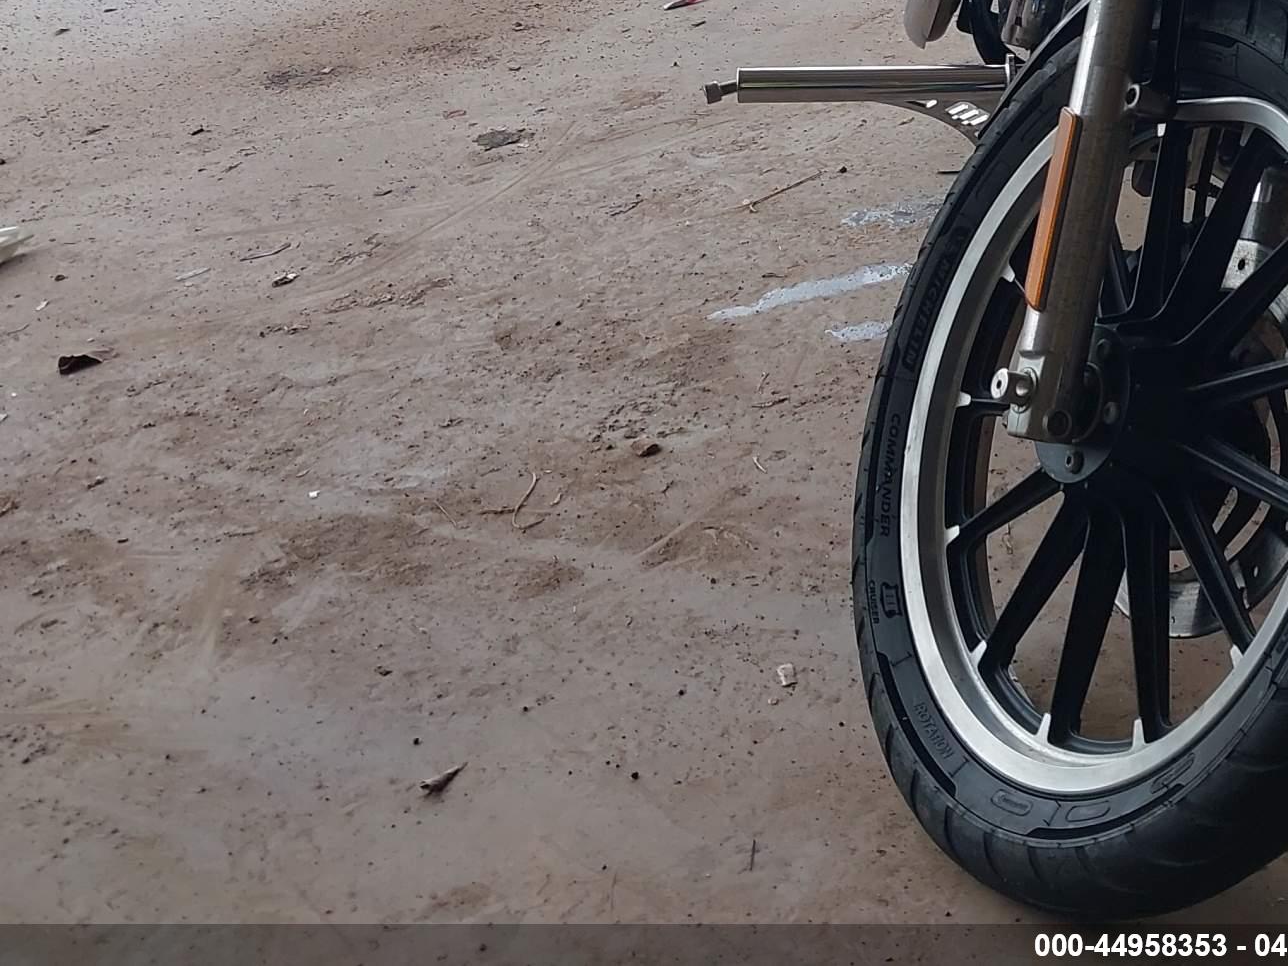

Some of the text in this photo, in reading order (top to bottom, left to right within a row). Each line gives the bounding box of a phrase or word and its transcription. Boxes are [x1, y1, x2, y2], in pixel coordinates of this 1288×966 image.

[880, 413, 901, 537] COMMANDER
[869, 580, 880, 624] CRUISER
[913, 702, 955, 760] ROTATION
